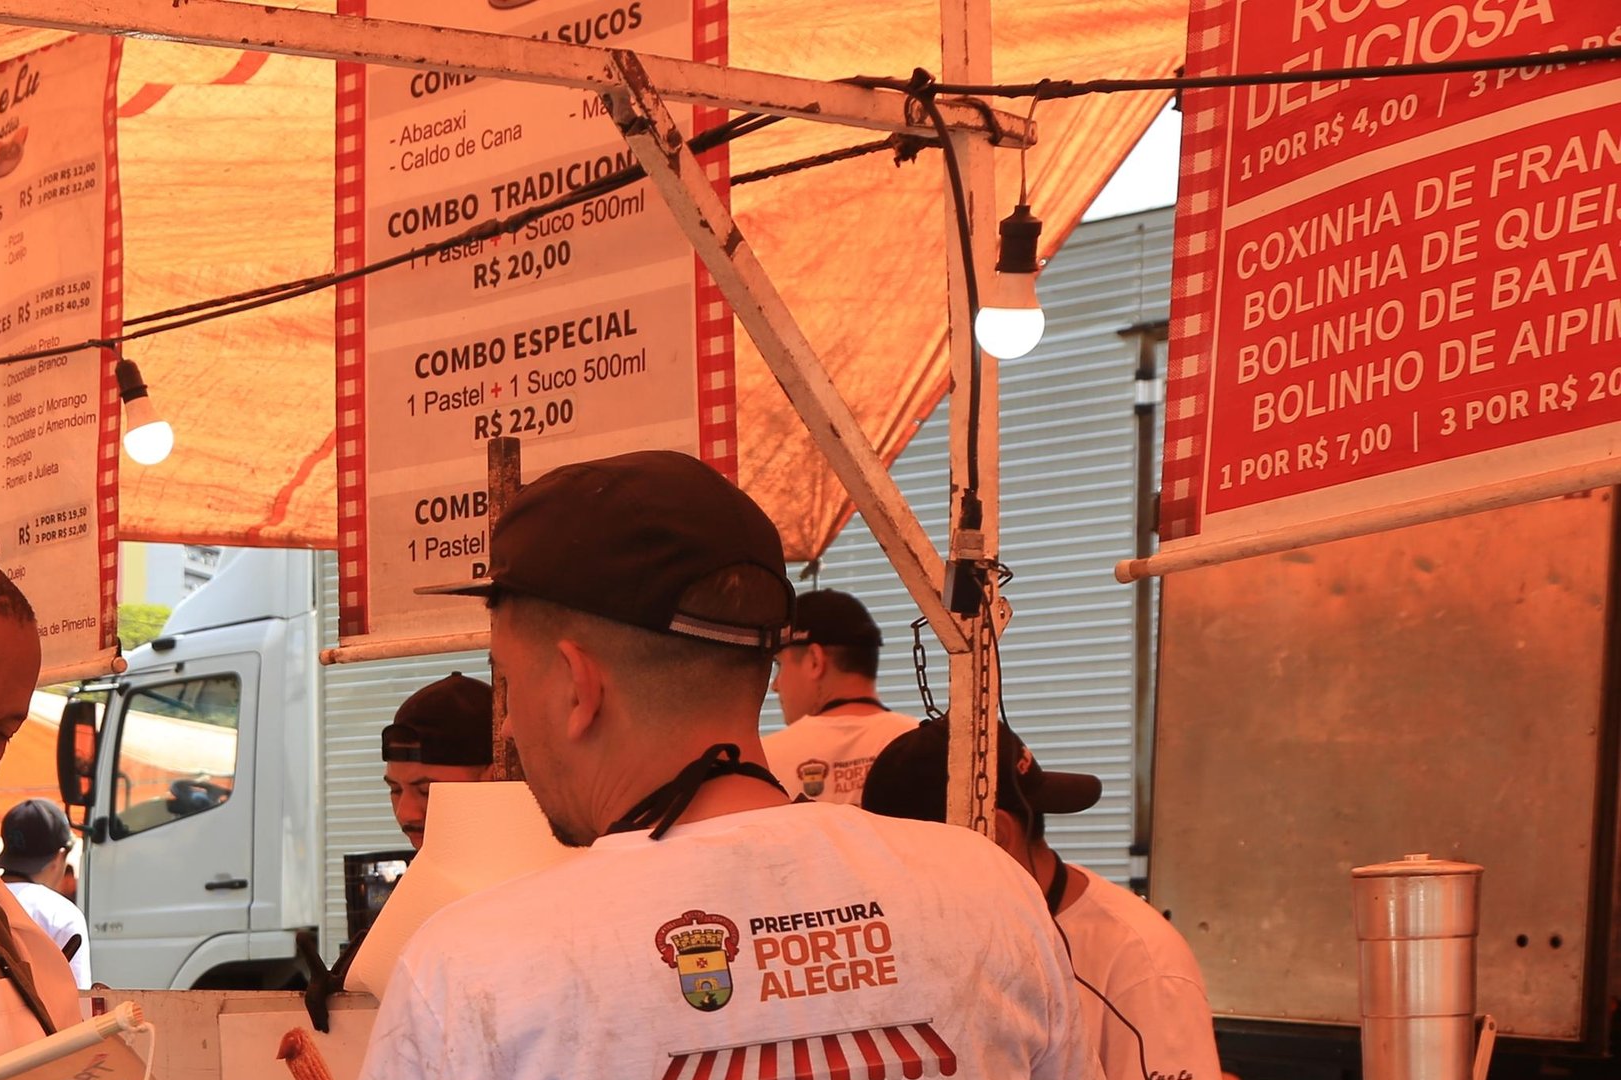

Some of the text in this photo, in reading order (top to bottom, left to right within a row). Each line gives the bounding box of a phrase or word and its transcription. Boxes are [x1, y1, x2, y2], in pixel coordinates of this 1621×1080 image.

[11, 63, 40, 109] Lu
[1246, 0, 1555, 131] DELICIOSA
[399, 110, 467, 147] Abacaxi
[1241, 155, 1251, 181] 1
[1259, 133, 1307, 174] POR
[1314, 112, 1345, 152] R$
[1352, 94, 1418, 139] 4,00
[1469, 71, 1486, 98] 3
[401, 123, 523, 173] Caldo de Cana
[20, 186, 33, 209] R$
[43, 172, 59, 186] POR
[60, 168, 72, 181] R$
[387, 193, 479, 238] COMBO
[424, 188, 645, 267] Pastel Suco 500ml
[1236, 192, 1401, 280] COXINHA
[1414, 166, 1475, 221] DE
[474, 239, 571, 289] R$ 20,00
[1243, 183, 1621, 331] BOLINHA DE QUEI
[40, 288, 54, 301] POR
[55, 284, 66, 298] R$
[67, 280, 91, 295] 15,00
[40, 305, 54, 318] POR
[55, 300, 66, 314] R$
[66, 296, 90, 312] 40,50
[18, 302, 31, 326] R$
[1237, 241, 1621, 385] BOLINHO DE BATA
[414, 309, 638, 379] COMBO ESPECIAL
[407, 395, 416, 417] 1
[424, 382, 484, 414] Pastel
[509, 374, 519, 398] 1
[527, 367, 577, 395] Suco
[583, 348, 646, 384] 500ml
[1252, 329, 1497, 432] BOLINHO DE
[45, 412, 97, 434] Amendoim
[46, 394, 88, 412] Morango
[474, 399, 574, 440] R$ 22,00
[1219, 374, 1578, 490] 1 POR R$ 7,00 3 POR R$
[40, 513, 56, 526] POR
[57, 510, 68, 523] R$
[414, 490, 488, 525] COMB
[18, 522, 31, 546] R$
[41, 530, 57, 542] POR
[57, 527, 68, 539] R$
[408, 530, 485, 562] 1 Pastel
[49, 615, 97, 636] de Pimenta
[749, 901, 884, 936] PREFEITURA
[753, 921, 892, 971] PORTO
[759, 955, 898, 1002] ALEGRE
